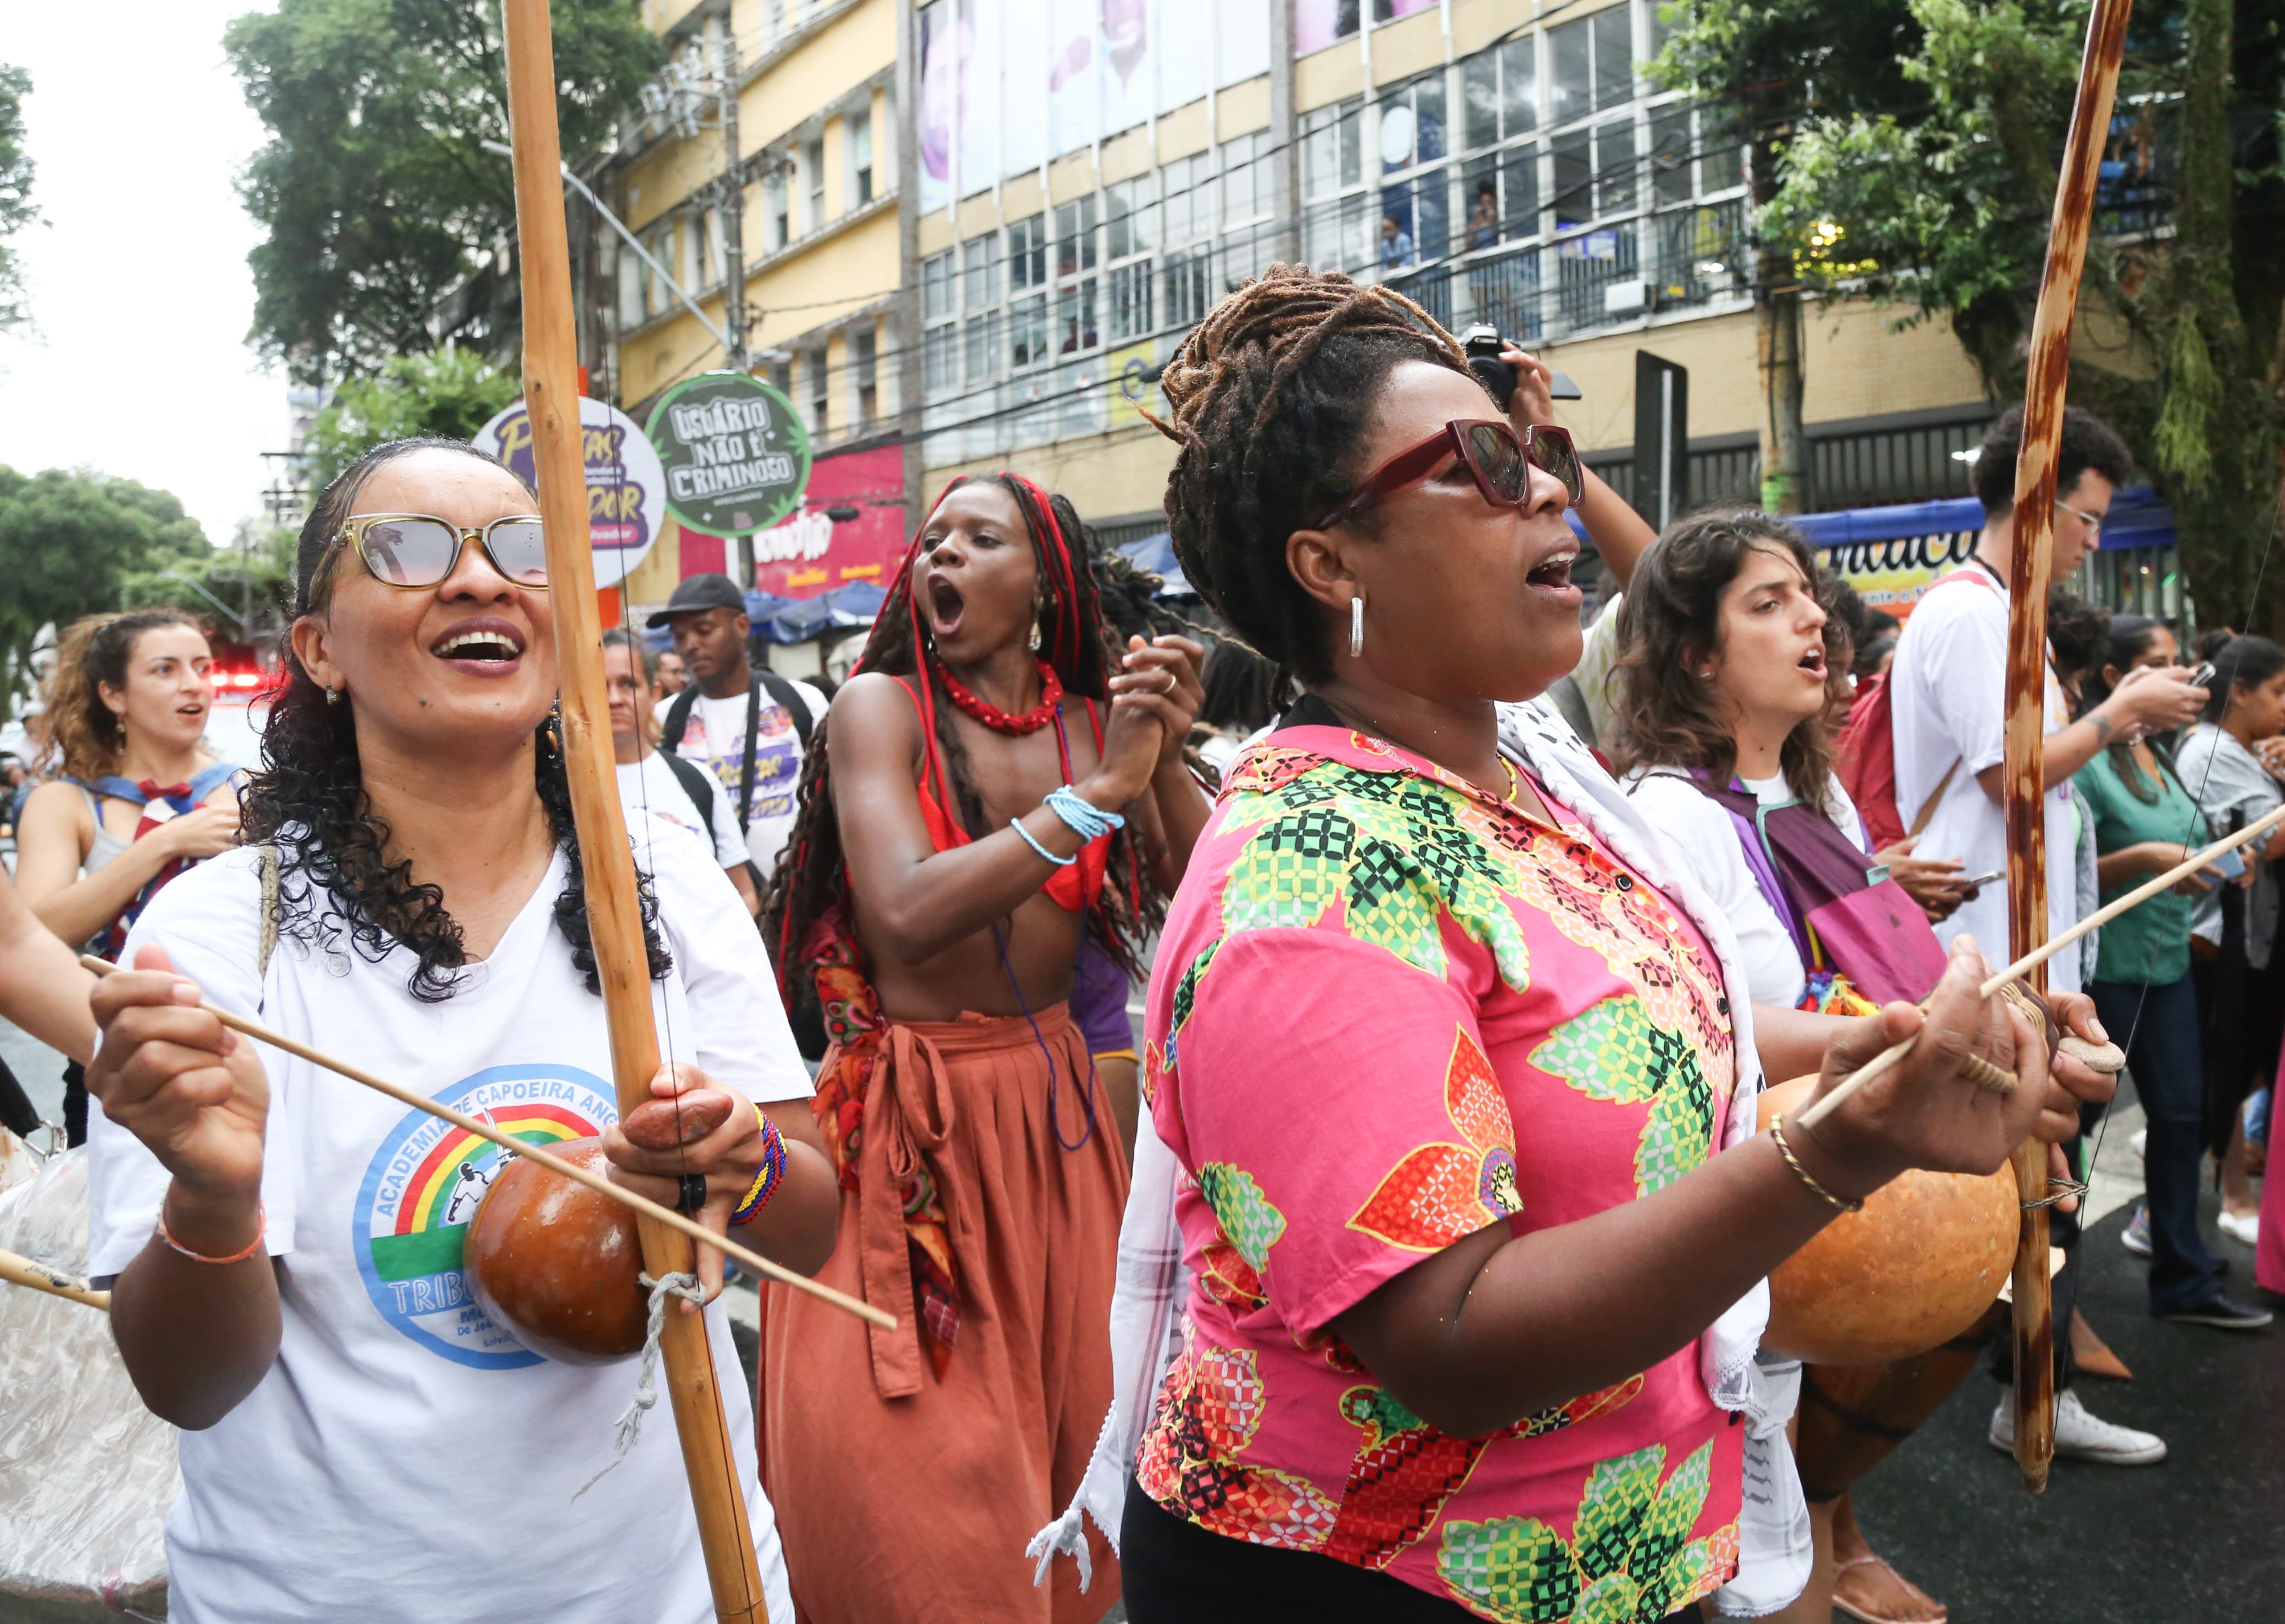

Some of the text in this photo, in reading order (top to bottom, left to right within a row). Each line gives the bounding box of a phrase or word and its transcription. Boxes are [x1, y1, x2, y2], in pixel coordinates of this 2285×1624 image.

[675, 401, 766, 440] USUÁRIO
[696, 431, 762, 466] NÃO É
[673, 456, 790, 495] CRIMINOSO
[377, 1115, 451, 1218] ACADEMIA
[476, 1081, 575, 1106] CAPOEIRA
[579, 1095, 618, 1126] ANG
